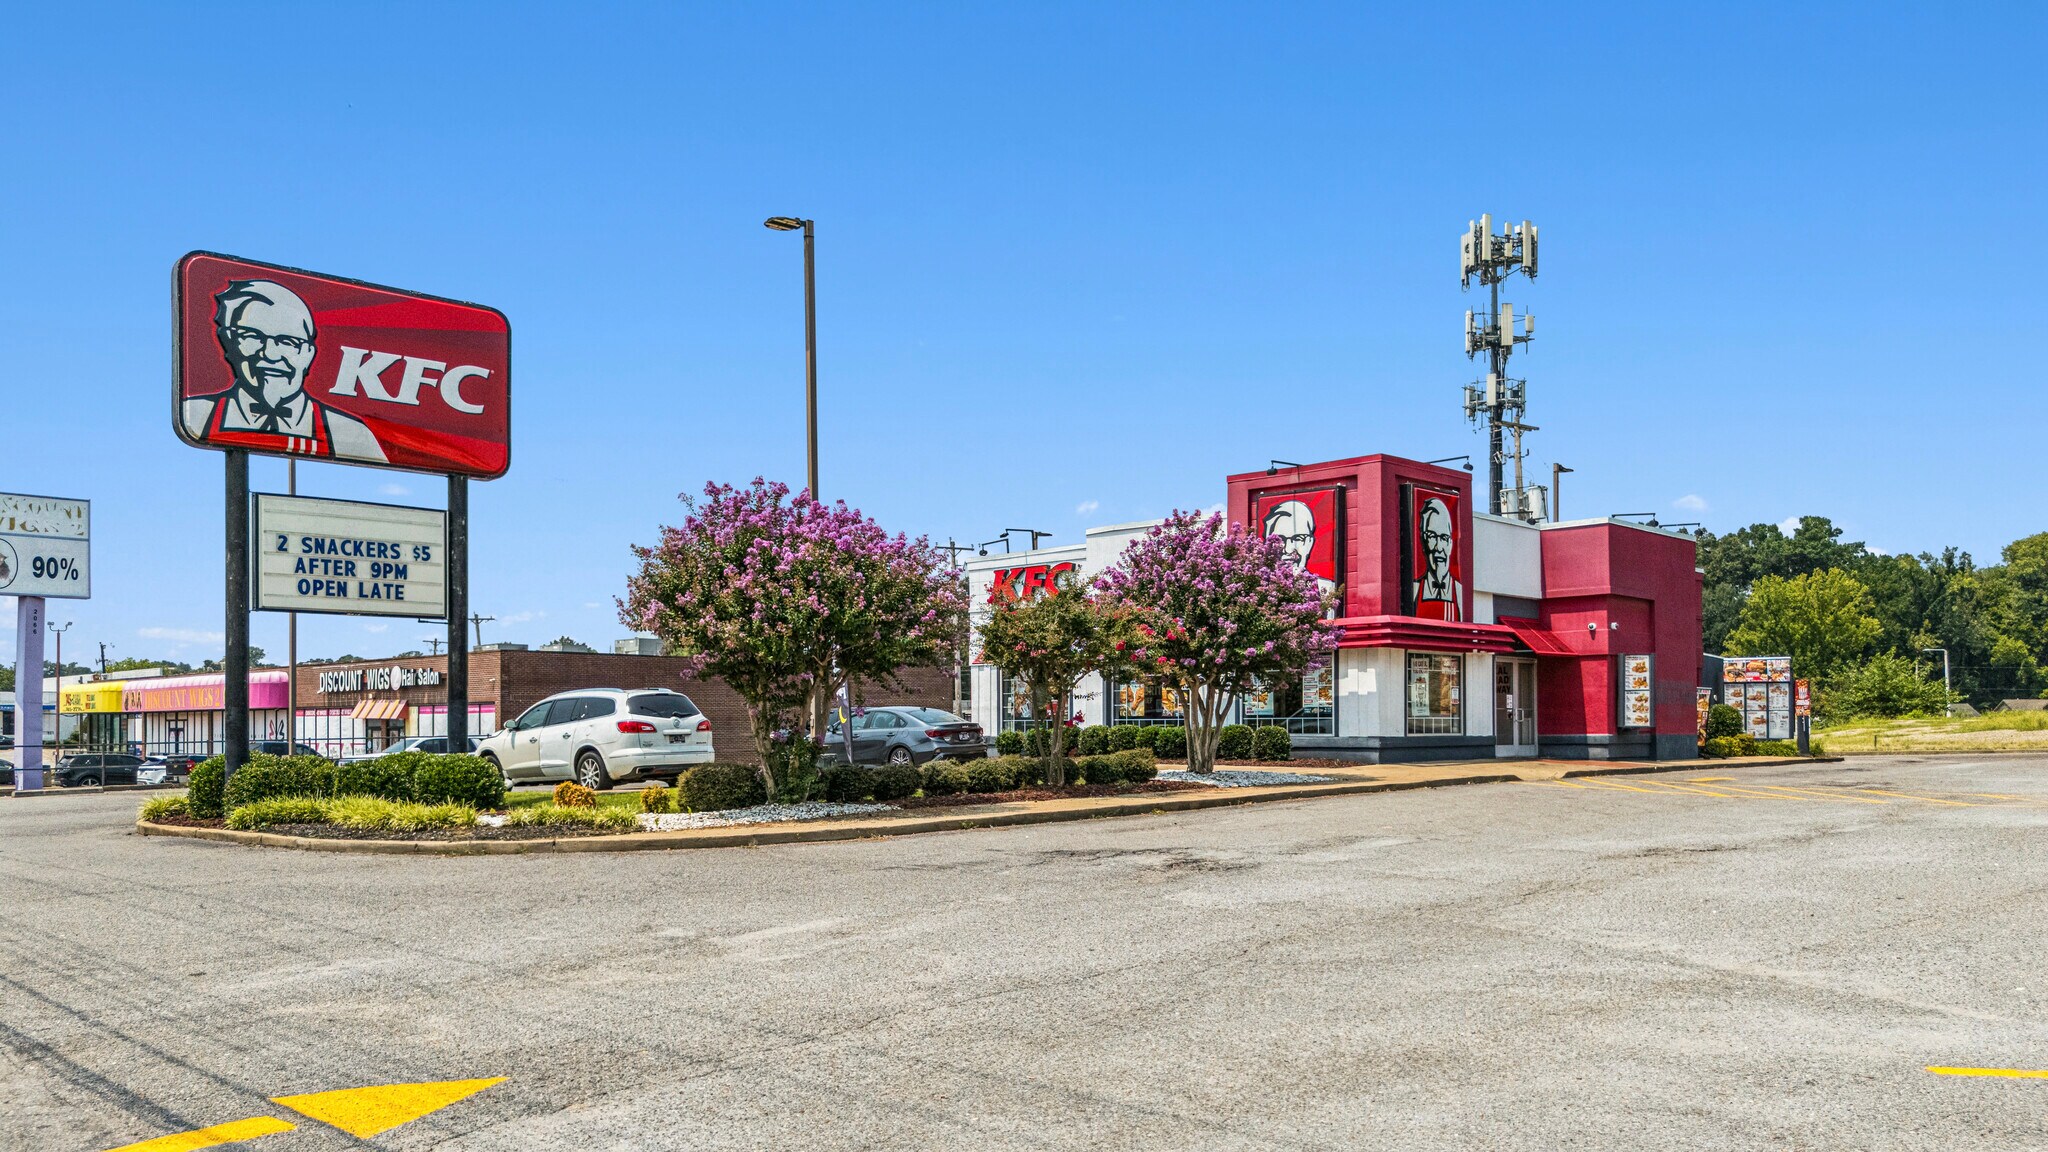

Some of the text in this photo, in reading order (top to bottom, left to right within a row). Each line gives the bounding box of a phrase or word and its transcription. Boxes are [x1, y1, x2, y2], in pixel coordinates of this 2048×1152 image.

[328, 345, 490, 415] KFC
[277, 535, 432, 562] 2 SNACKERS $5
[32, 556, 79, 581] 90%
[294, 557, 408, 580] AFTER 9PM
[297, 578, 405, 600] OPEN LATE
[993, 562, 1076, 603] KFC
[319, 669, 363, 693] DISCOUNT
[366, 667, 390, 690] WIGS
[401, 668, 416, 687] Hair
[418, 667, 439, 686] Salon
[146, 689, 187, 710] DISCOUNT
[189, 687, 214, 707] WIGS
